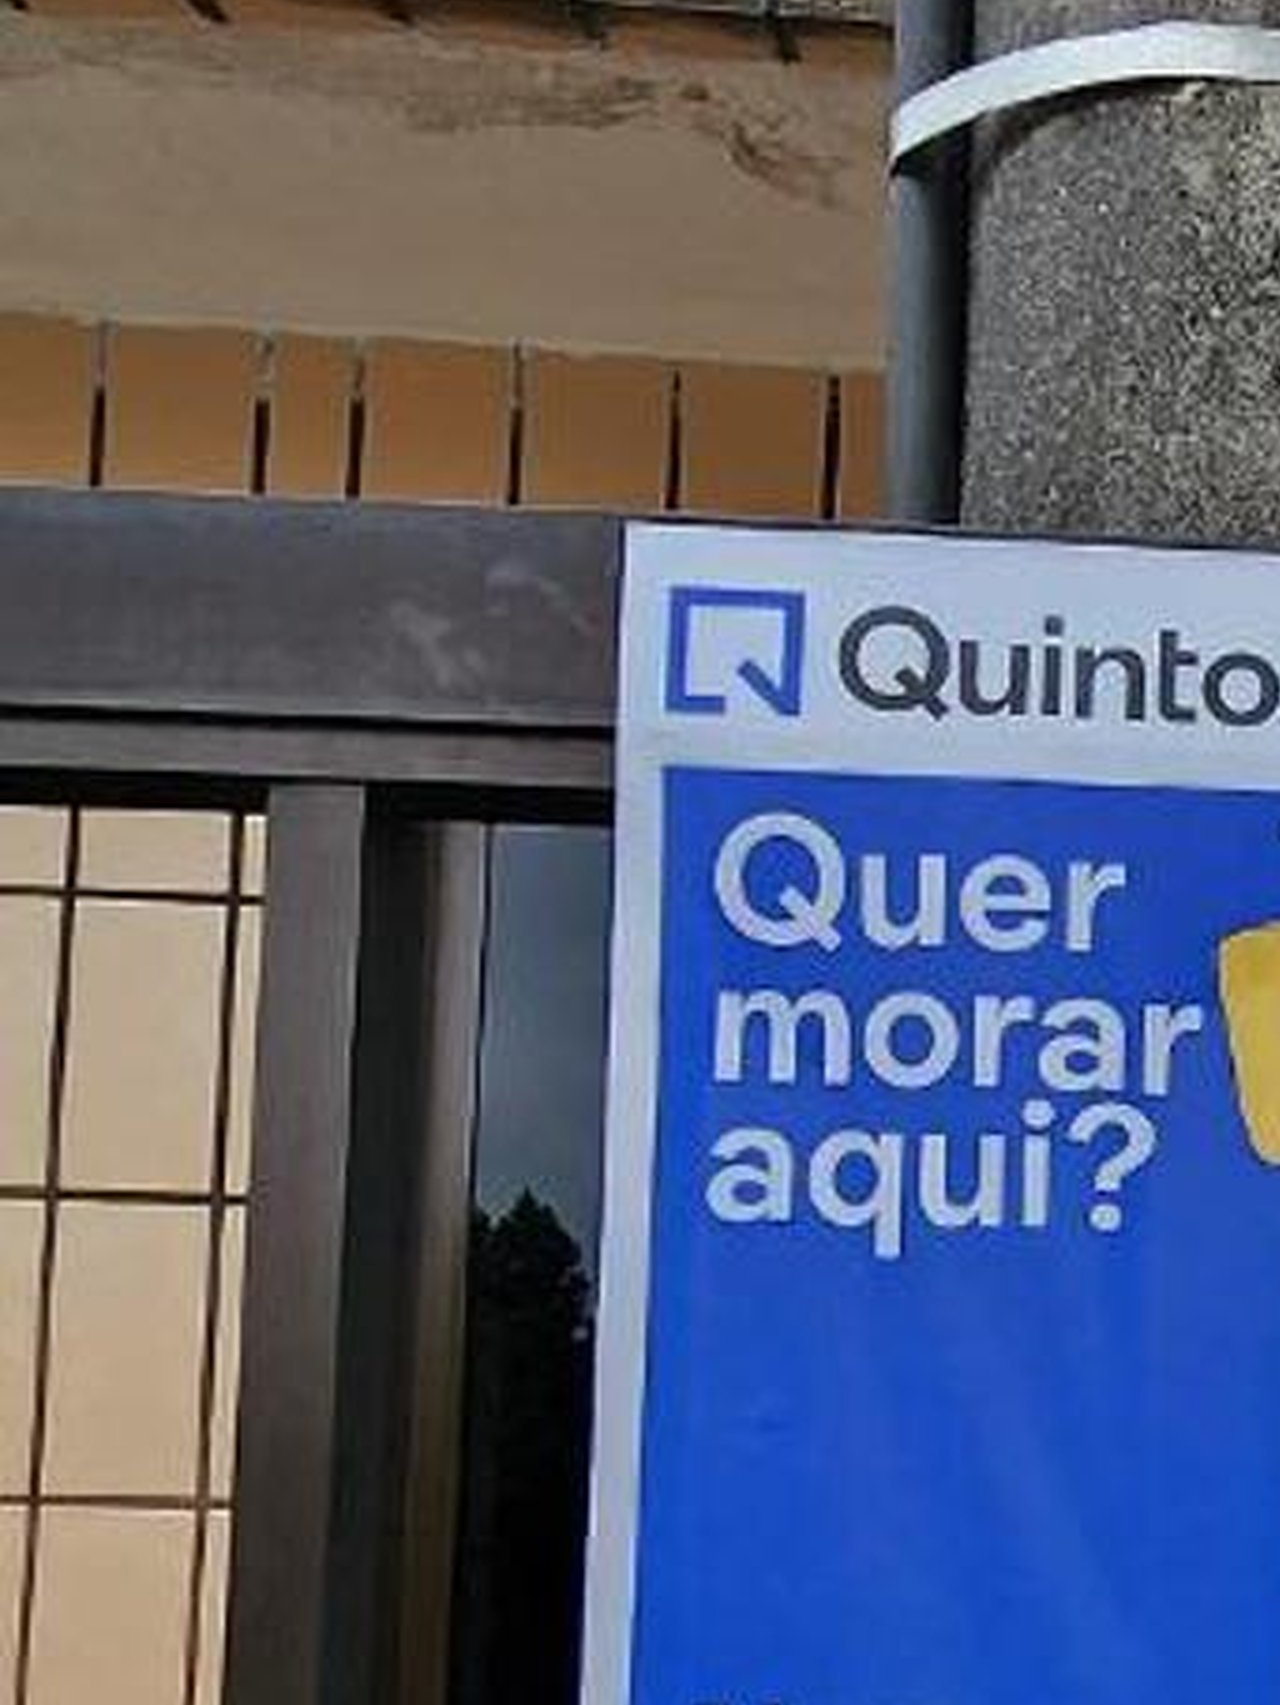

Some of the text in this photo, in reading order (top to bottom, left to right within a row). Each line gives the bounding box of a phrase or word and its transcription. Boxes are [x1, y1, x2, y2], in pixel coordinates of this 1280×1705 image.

[711, 811, 1126, 955] Quer
[710, 984, 1202, 1097] morar
[704, 1100, 1159, 1259] aqui?
